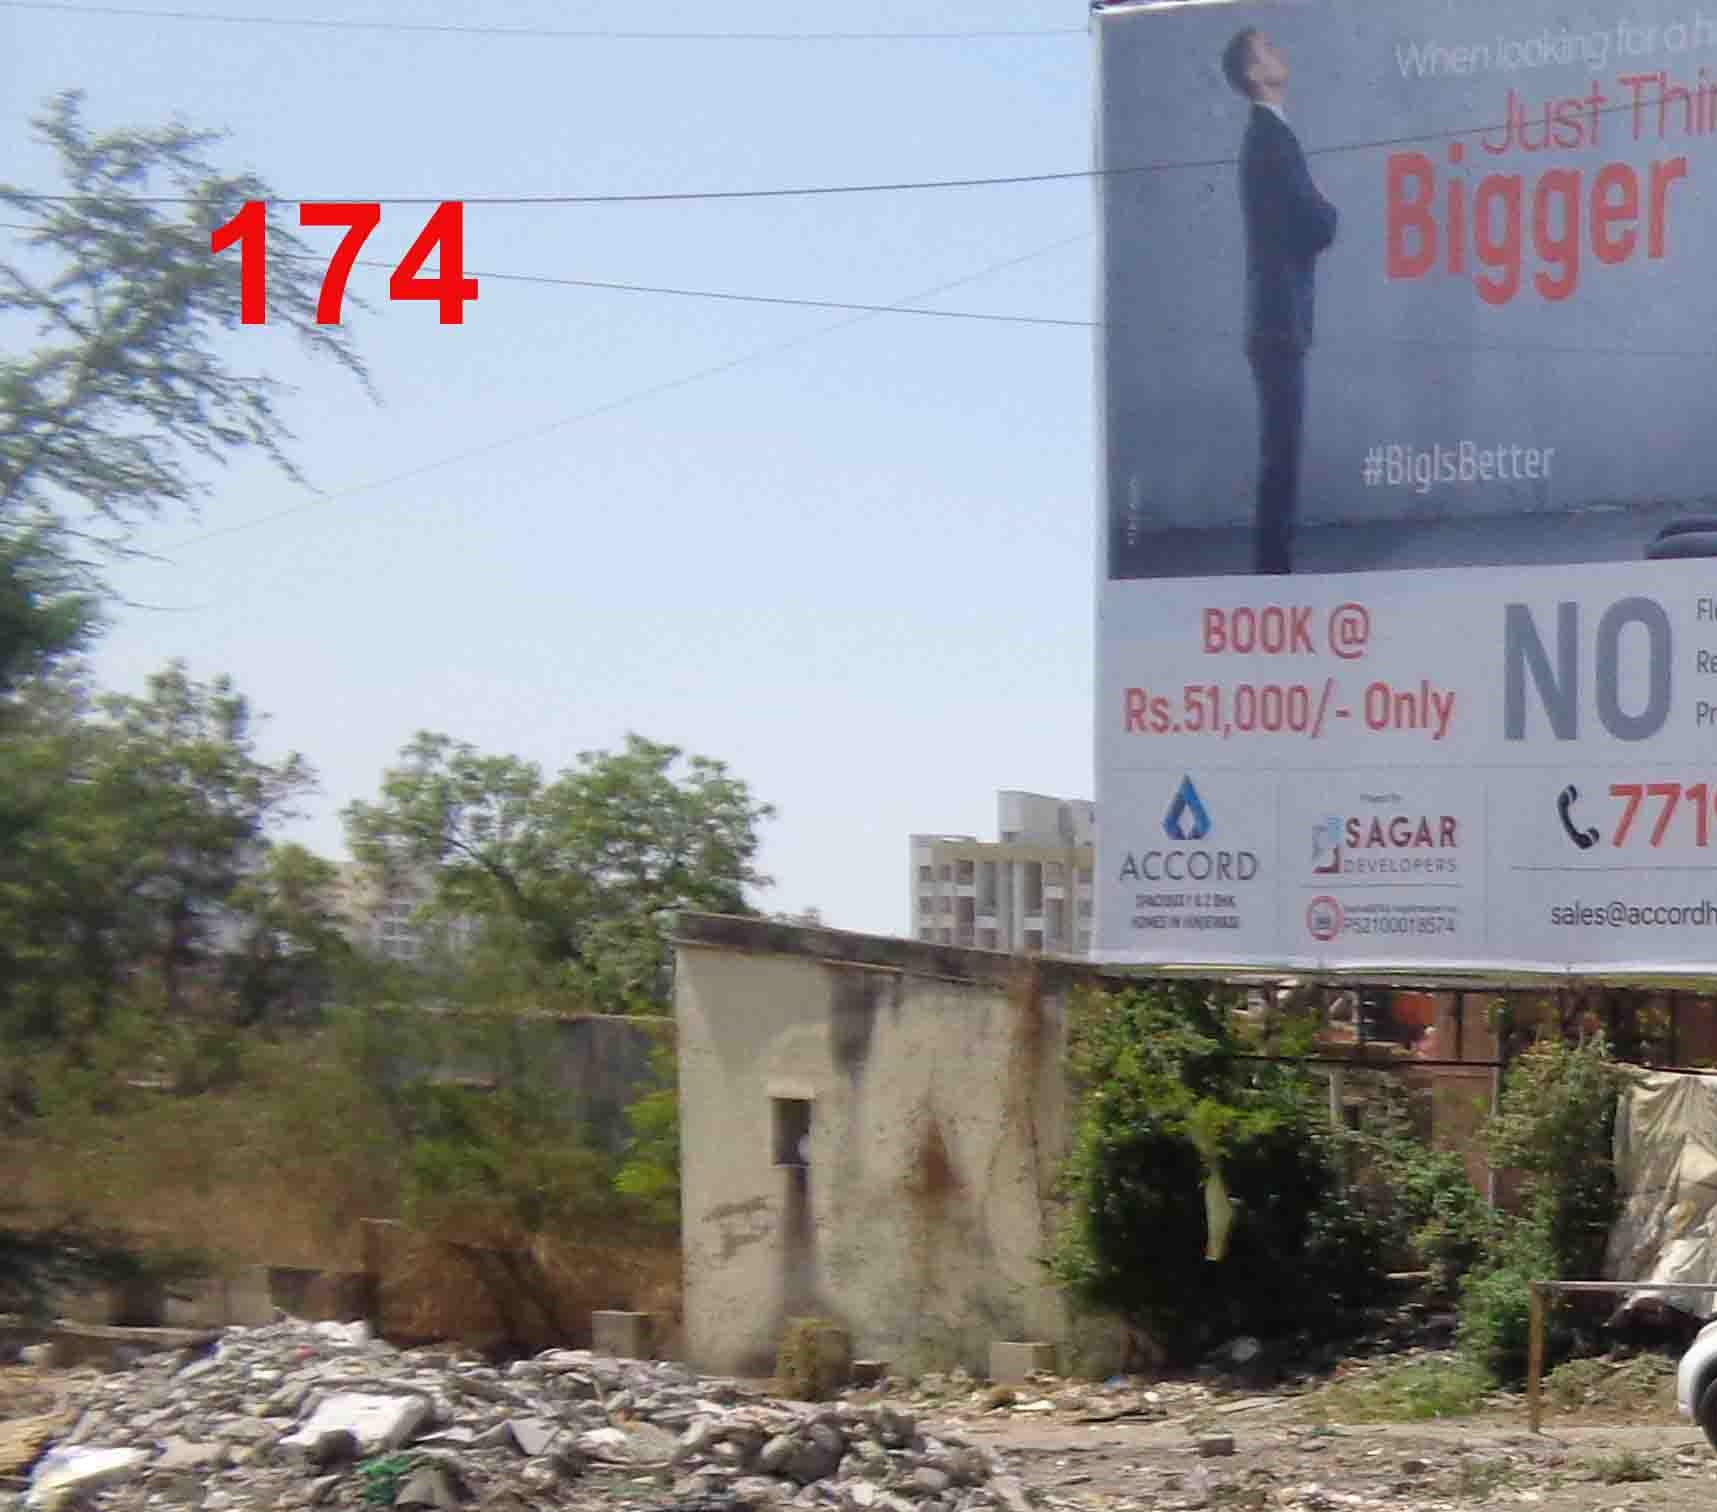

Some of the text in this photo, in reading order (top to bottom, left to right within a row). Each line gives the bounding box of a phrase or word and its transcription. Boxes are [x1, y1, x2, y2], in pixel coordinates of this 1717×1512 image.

[1395, 39, 1489, 77] When
[1498, 28, 1608, 71] looking
[1617, 18, 1658, 56] for
[1663, 22, 1686, 50] a
[1480, 80, 1606, 155] Just
[1385, 144, 1687, 305] Bigger
[1362, 443, 1554, 493] #BigIsBetter
[1203, 603, 1370, 660] BOOK @
[1503, 596, 1674, 742] NO
[1123, 679, 1456, 742] Rs.51,000/- Only
[1345, 815, 1458, 849] SAGAR
[1119, 851, 1257, 881] ACCORD
[1344, 858, 1458, 874] DEVELOPERS
